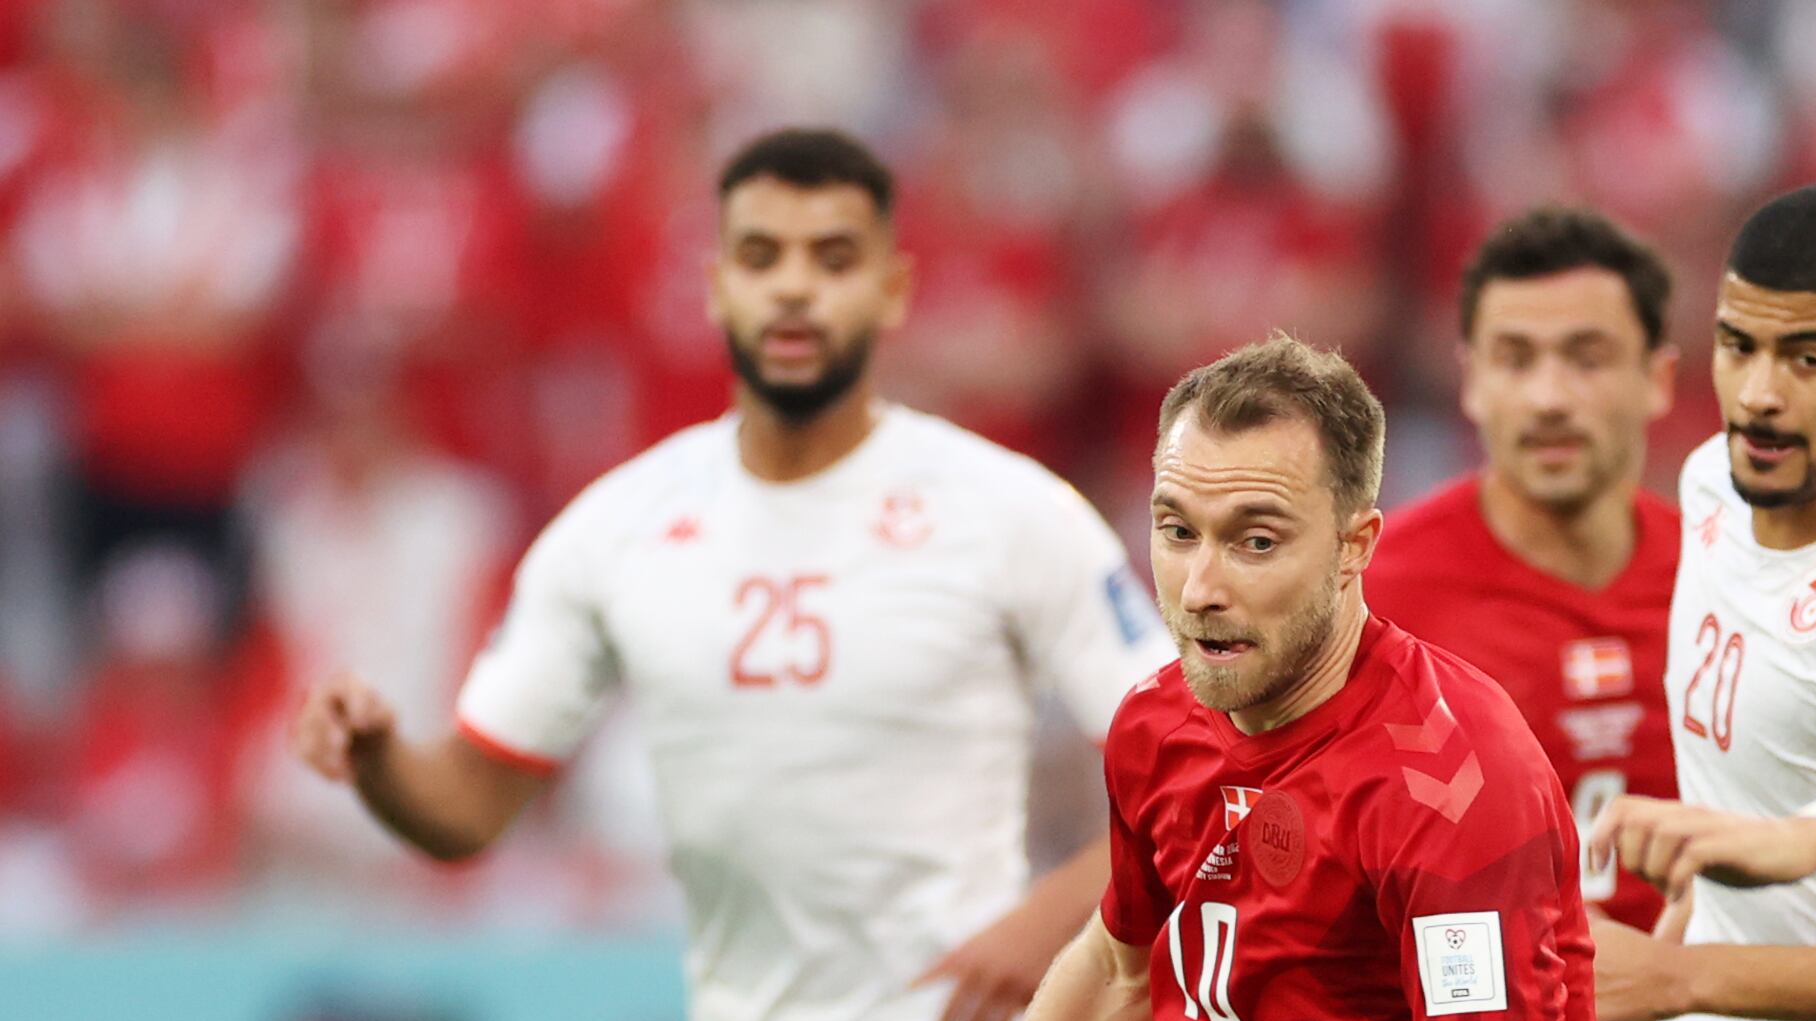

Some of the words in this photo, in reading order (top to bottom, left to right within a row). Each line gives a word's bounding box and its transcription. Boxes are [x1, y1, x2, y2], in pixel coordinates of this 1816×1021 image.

[730, 575, 833, 690] 25
[1683, 612, 1744, 752] 20
[1442, 964, 1475, 977] UNITES
